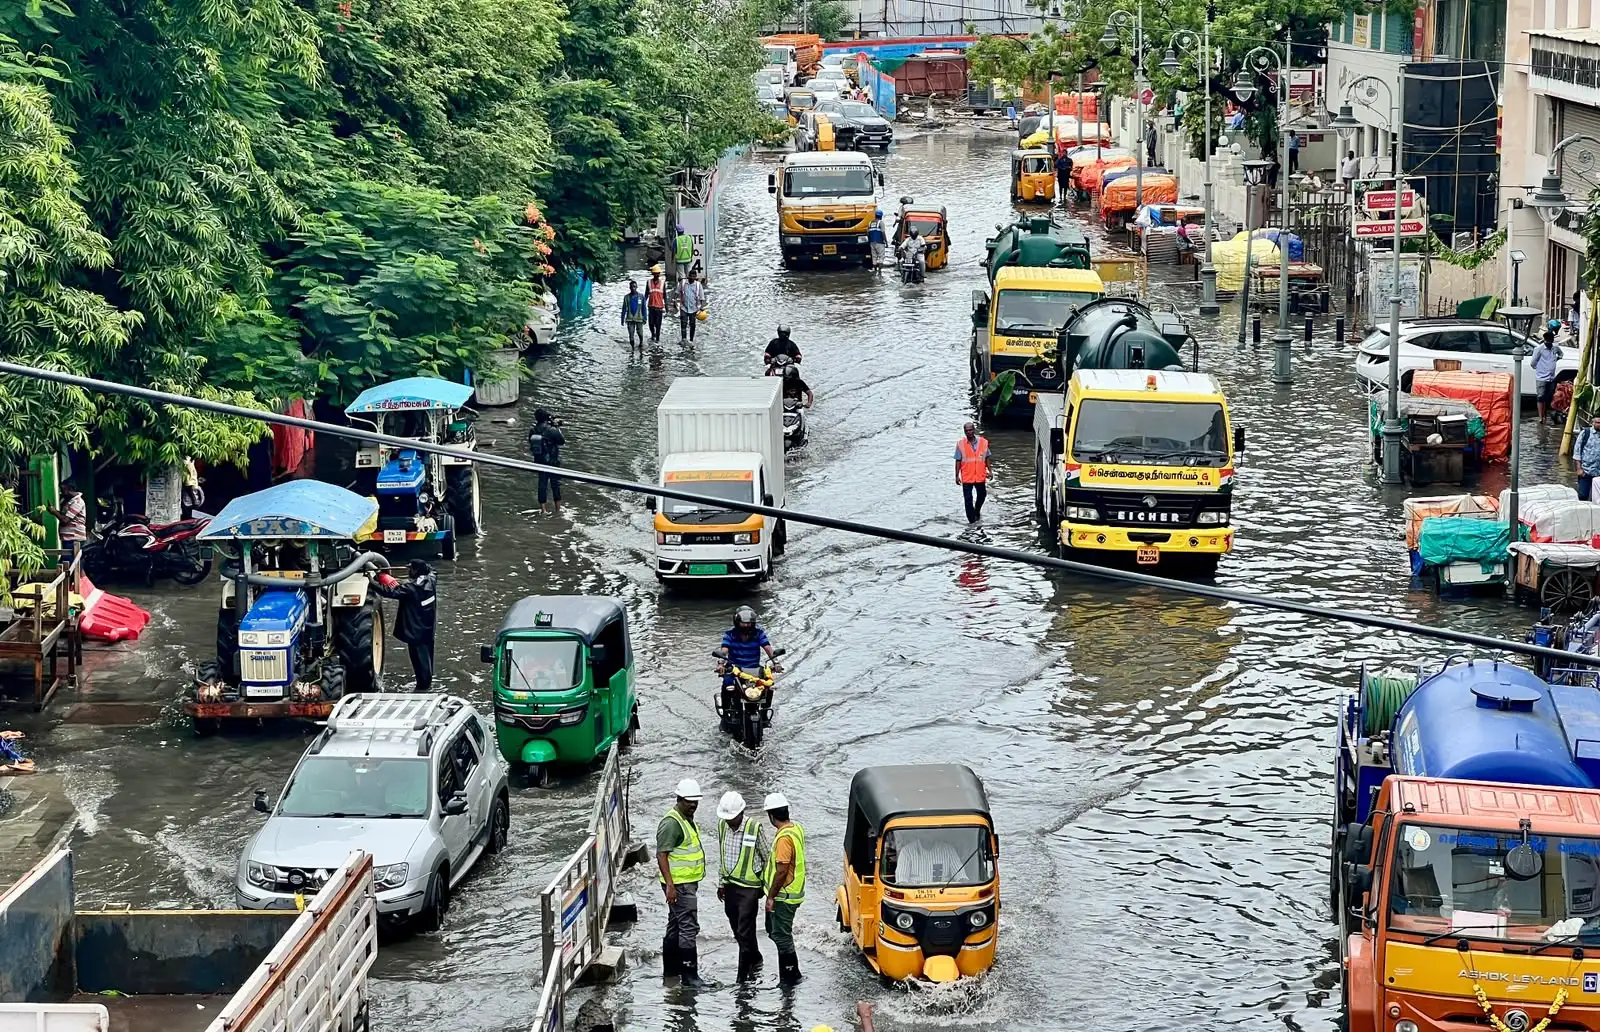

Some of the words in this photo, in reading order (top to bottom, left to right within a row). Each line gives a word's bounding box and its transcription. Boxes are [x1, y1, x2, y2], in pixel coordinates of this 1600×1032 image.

[1372, 225, 1387, 233] CAR
[1388, 223, 1417, 232] PAKING
[1117, 511, 1180, 522] EICHER
[1458, 969, 1509, 982] ASHOK
[1512, 973, 1580, 986] LEYLAND
